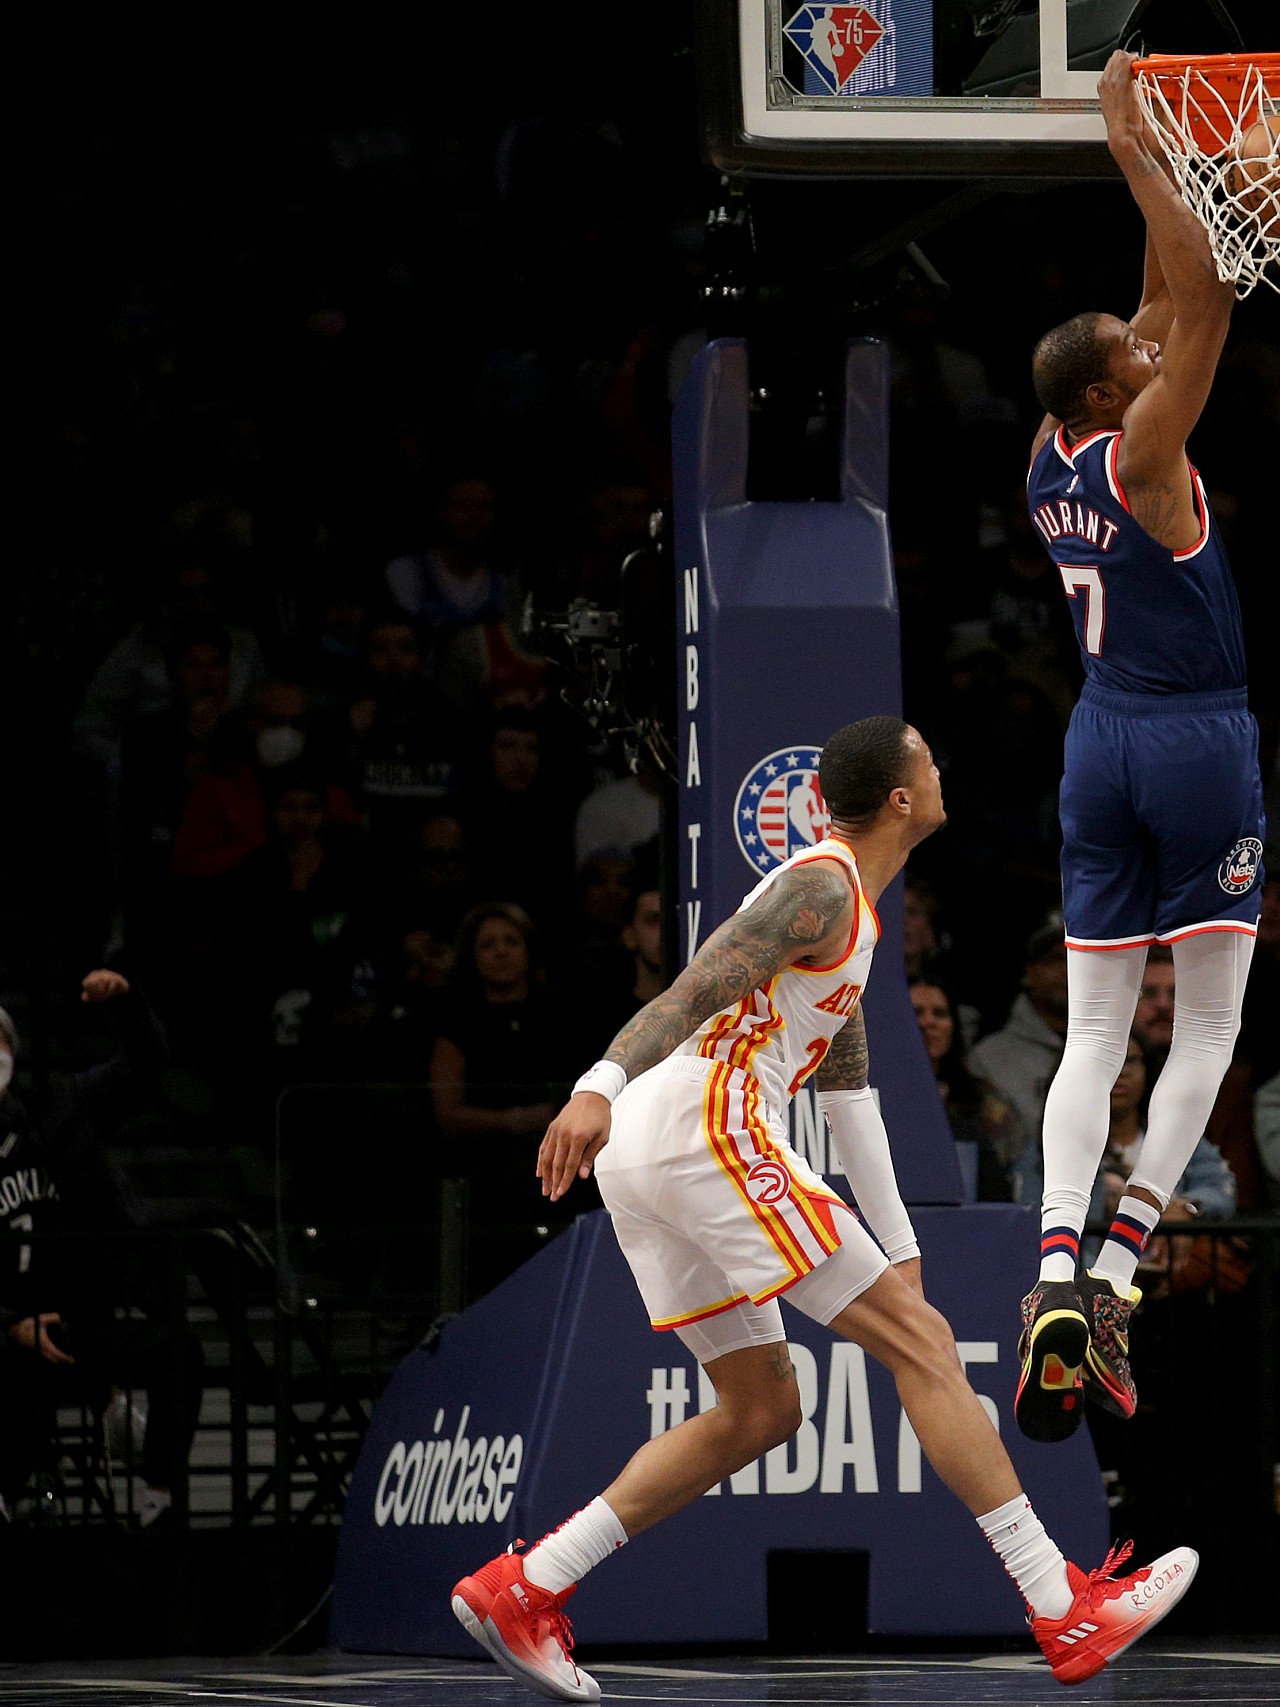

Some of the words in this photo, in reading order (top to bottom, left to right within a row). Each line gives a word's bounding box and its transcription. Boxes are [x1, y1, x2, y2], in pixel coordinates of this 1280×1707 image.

[844, 18, 863, 44] 75
[1057, 562, 1106, 657] 7
[684, 566, 701, 789] NBA
[1229, 862, 1256, 878] Nets
[375, 1405, 523, 1527] coinbase
